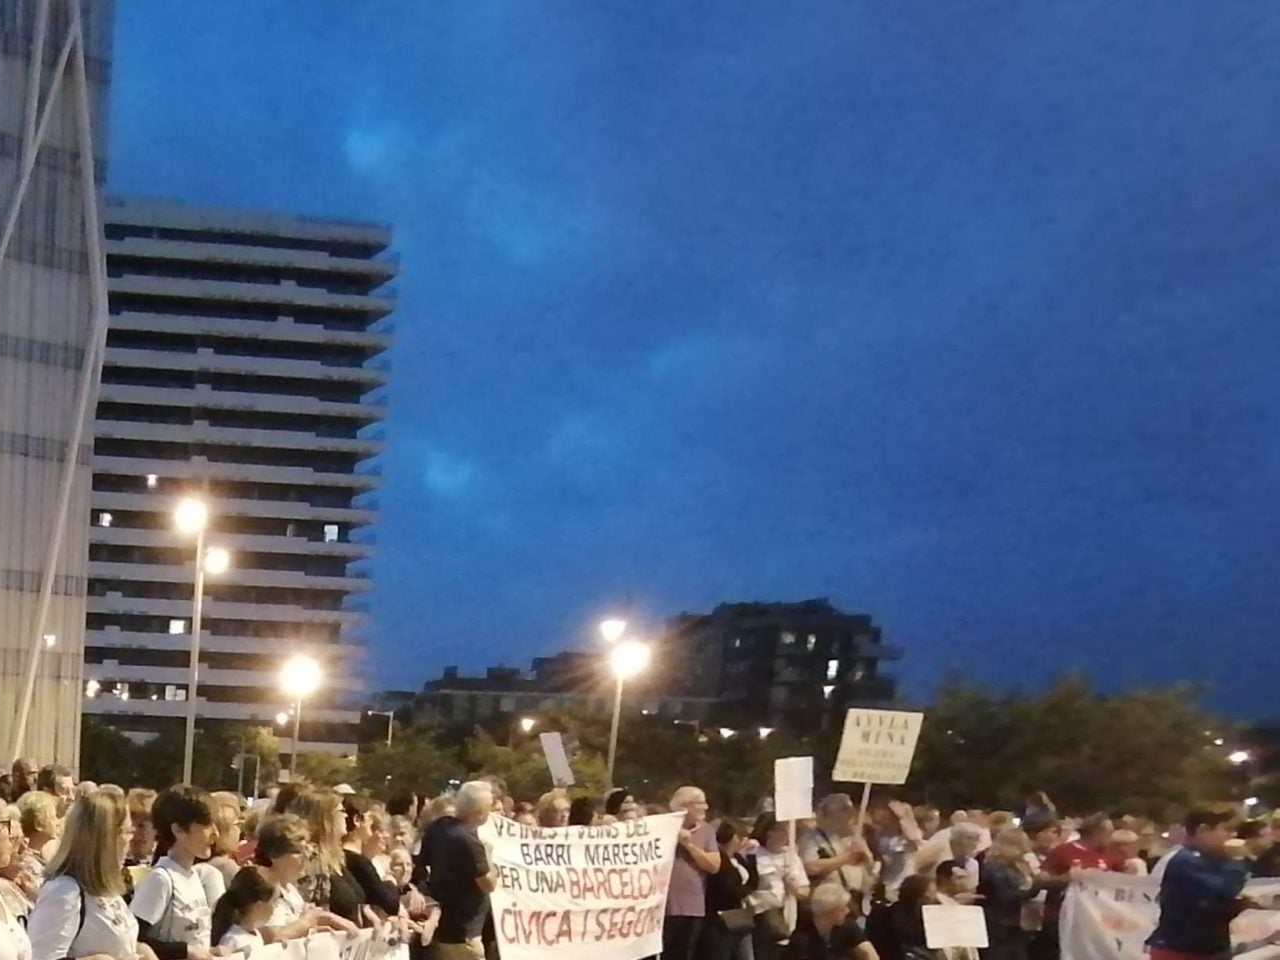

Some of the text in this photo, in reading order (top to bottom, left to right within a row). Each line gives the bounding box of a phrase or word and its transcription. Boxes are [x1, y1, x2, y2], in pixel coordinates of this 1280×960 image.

[626, 820, 650, 838] DEL
[521, 838, 663, 867] BARRI MARESME
[526, 868, 567, 894] UNA
